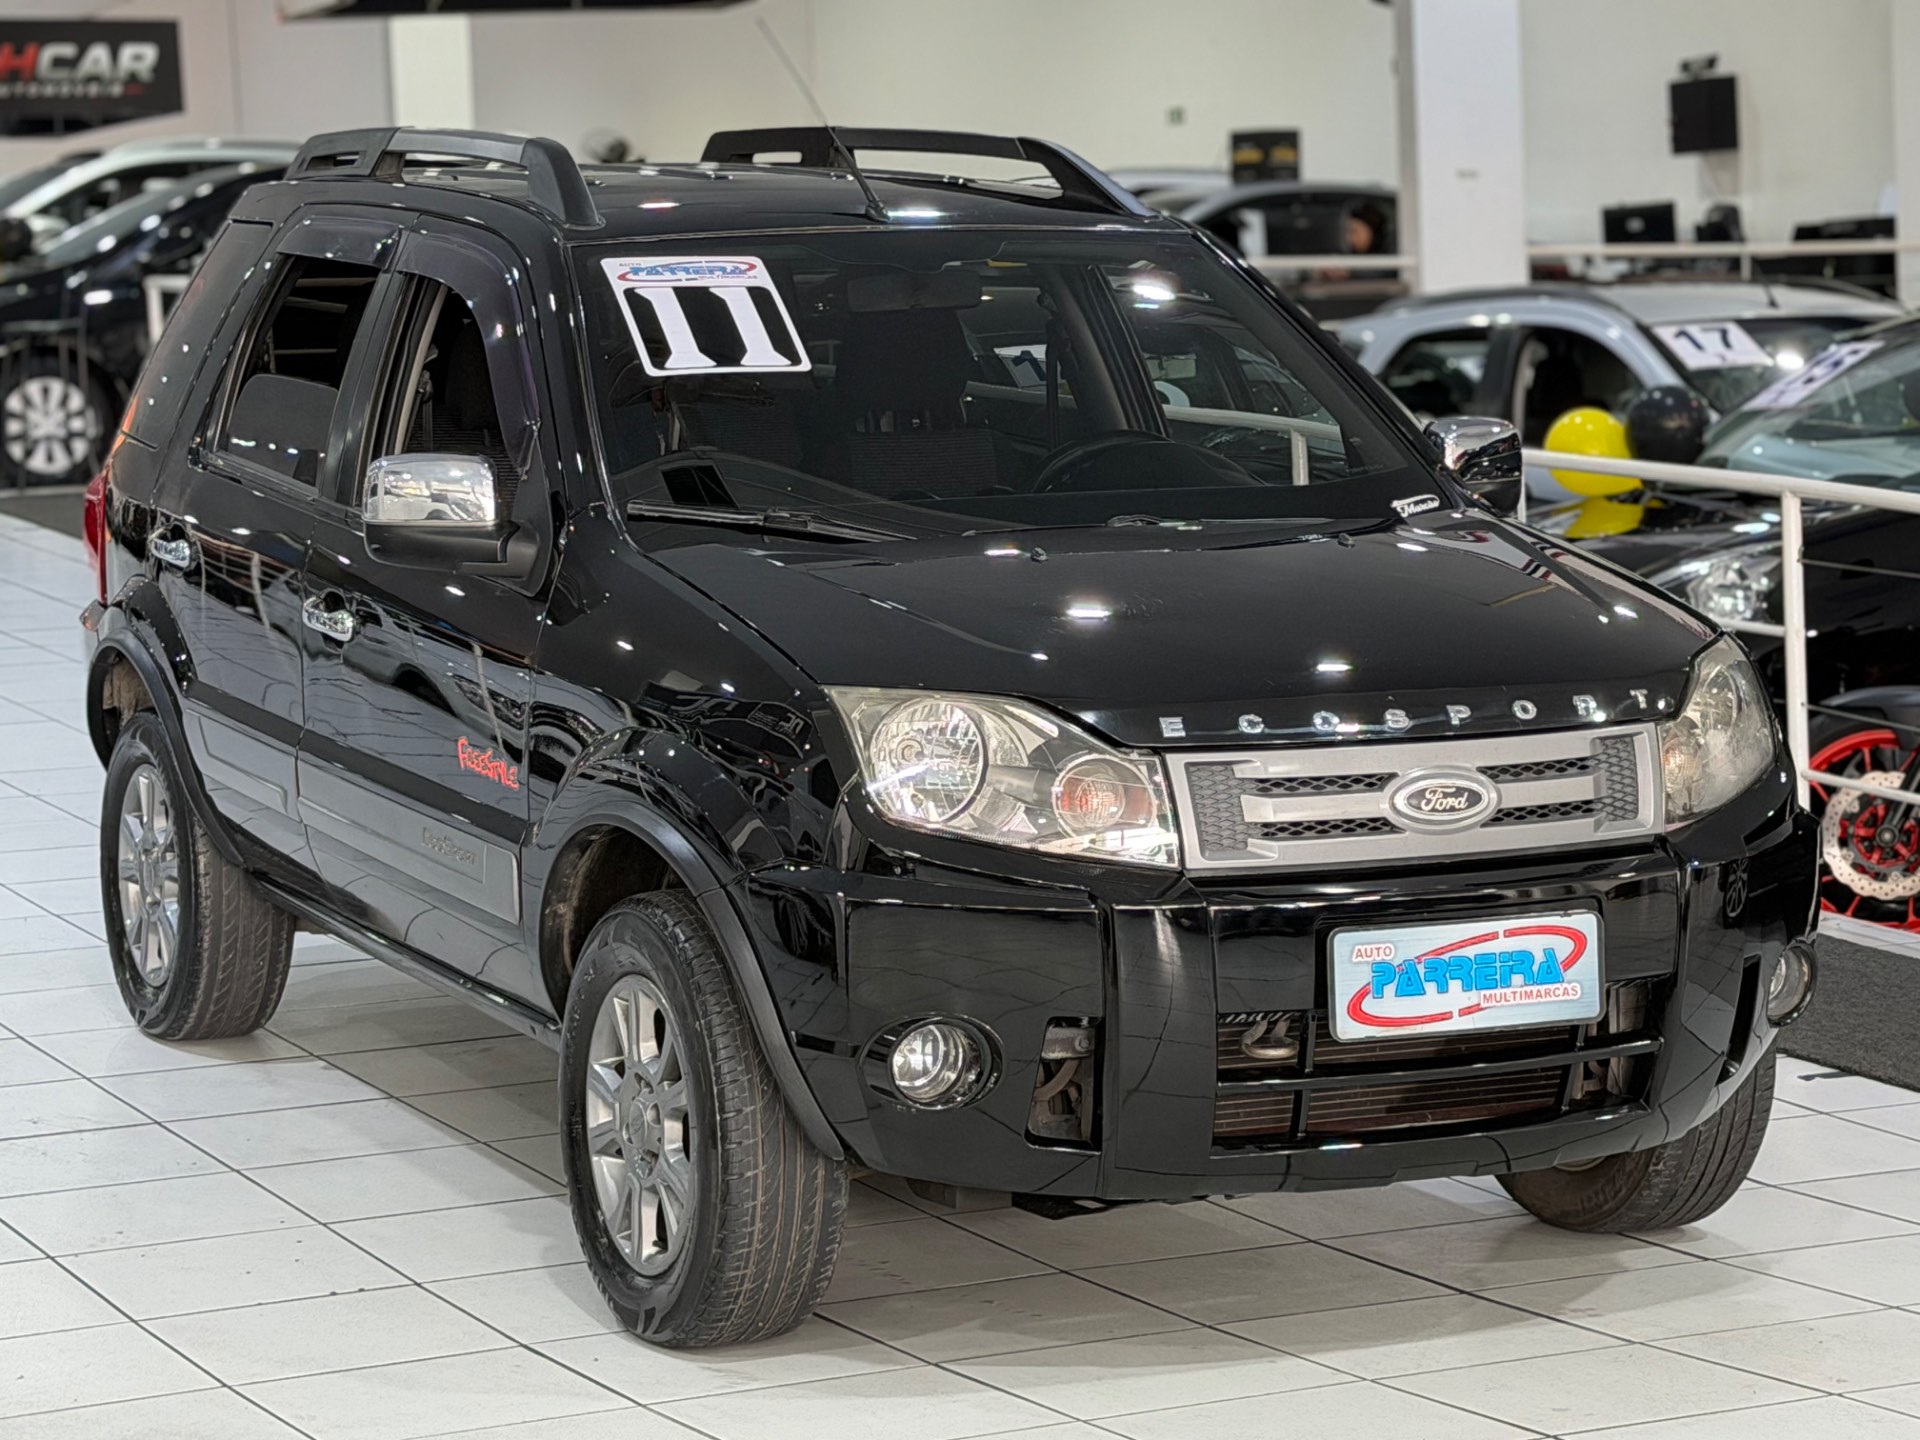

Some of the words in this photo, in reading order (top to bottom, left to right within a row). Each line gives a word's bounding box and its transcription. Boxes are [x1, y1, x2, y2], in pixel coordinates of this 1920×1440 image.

[634, 287, 792, 369] 11
[1674, 326, 1733, 352] 17
[1158, 689, 1648, 738] ECOSPORT
[1421, 787, 1468, 812] Ford
[1354, 945, 1393, 961] AUTO
[1371, 947, 1565, 999] PARREIRA
[1482, 984, 1579, 1006] MULTIMARCAS
